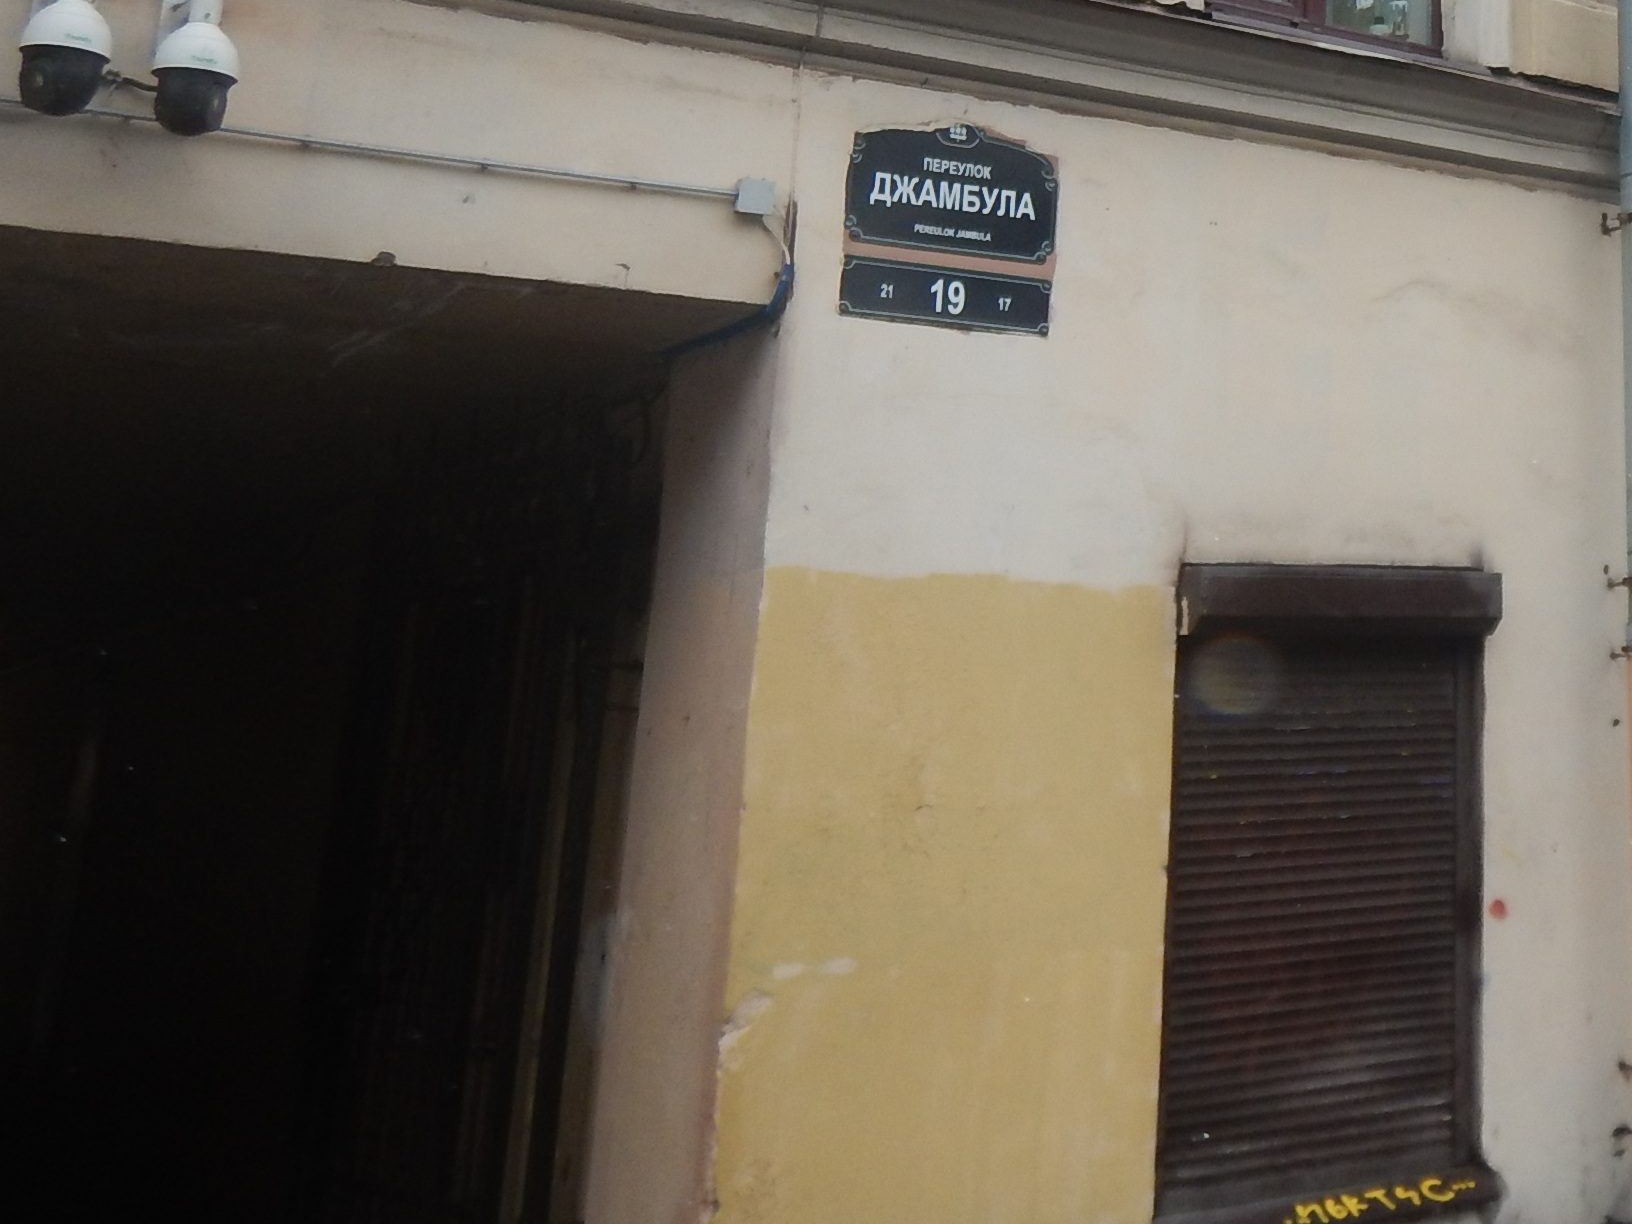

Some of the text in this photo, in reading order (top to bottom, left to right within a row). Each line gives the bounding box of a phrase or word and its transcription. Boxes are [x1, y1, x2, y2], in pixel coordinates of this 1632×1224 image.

[923, 156, 993, 180] ПЕРЕУЛОК
[869, 171, 1037, 221] ДЖАМБУЛА
[913, 223, 992, 242] PEREULOK JAMBULA
[880, 278, 1012, 316] 21 19 17
